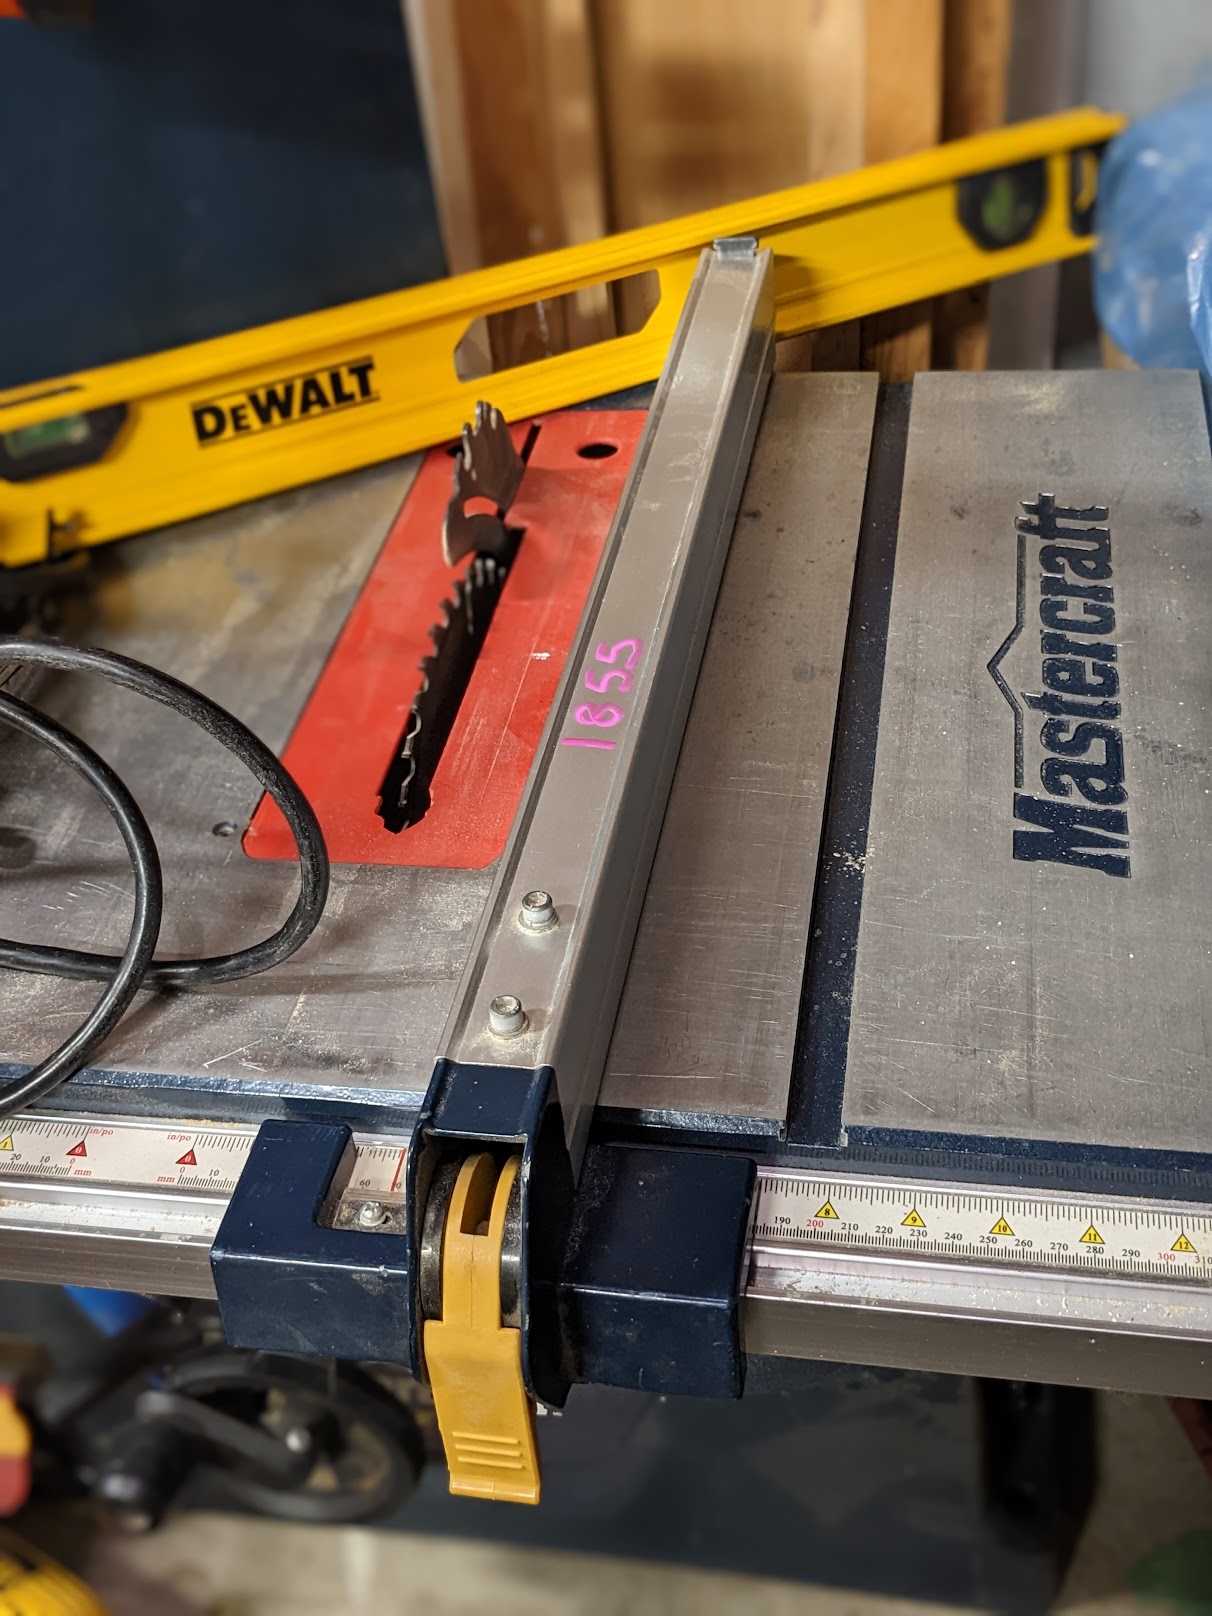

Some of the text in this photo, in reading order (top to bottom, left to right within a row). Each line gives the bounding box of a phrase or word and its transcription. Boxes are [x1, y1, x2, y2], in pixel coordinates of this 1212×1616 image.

[1012, 492, 1131, 879] Mastercraft
[560, 637, 644, 750] 1855
[89, 1127, 114, 1136] in/po
[167, 1132, 192, 1143] in/po
[75, 1146, 82, 1154] 0
[10, 1153, 76, 1165] 20 10 0
[185, 1155, 192, 1163] 0
[73, 1169, 92, 1177] mm
[179, 1166, 220, 1177] 0 10
[157, 1175, 175, 1183] mm
[360, 1179, 371, 1187] 60
[824, 1208, 1189, 1250] 8 9 10 11 12
[774, 1216, 1212, 1265] 190 200 210 220 230 240 250 260 270 280 290 300 310
